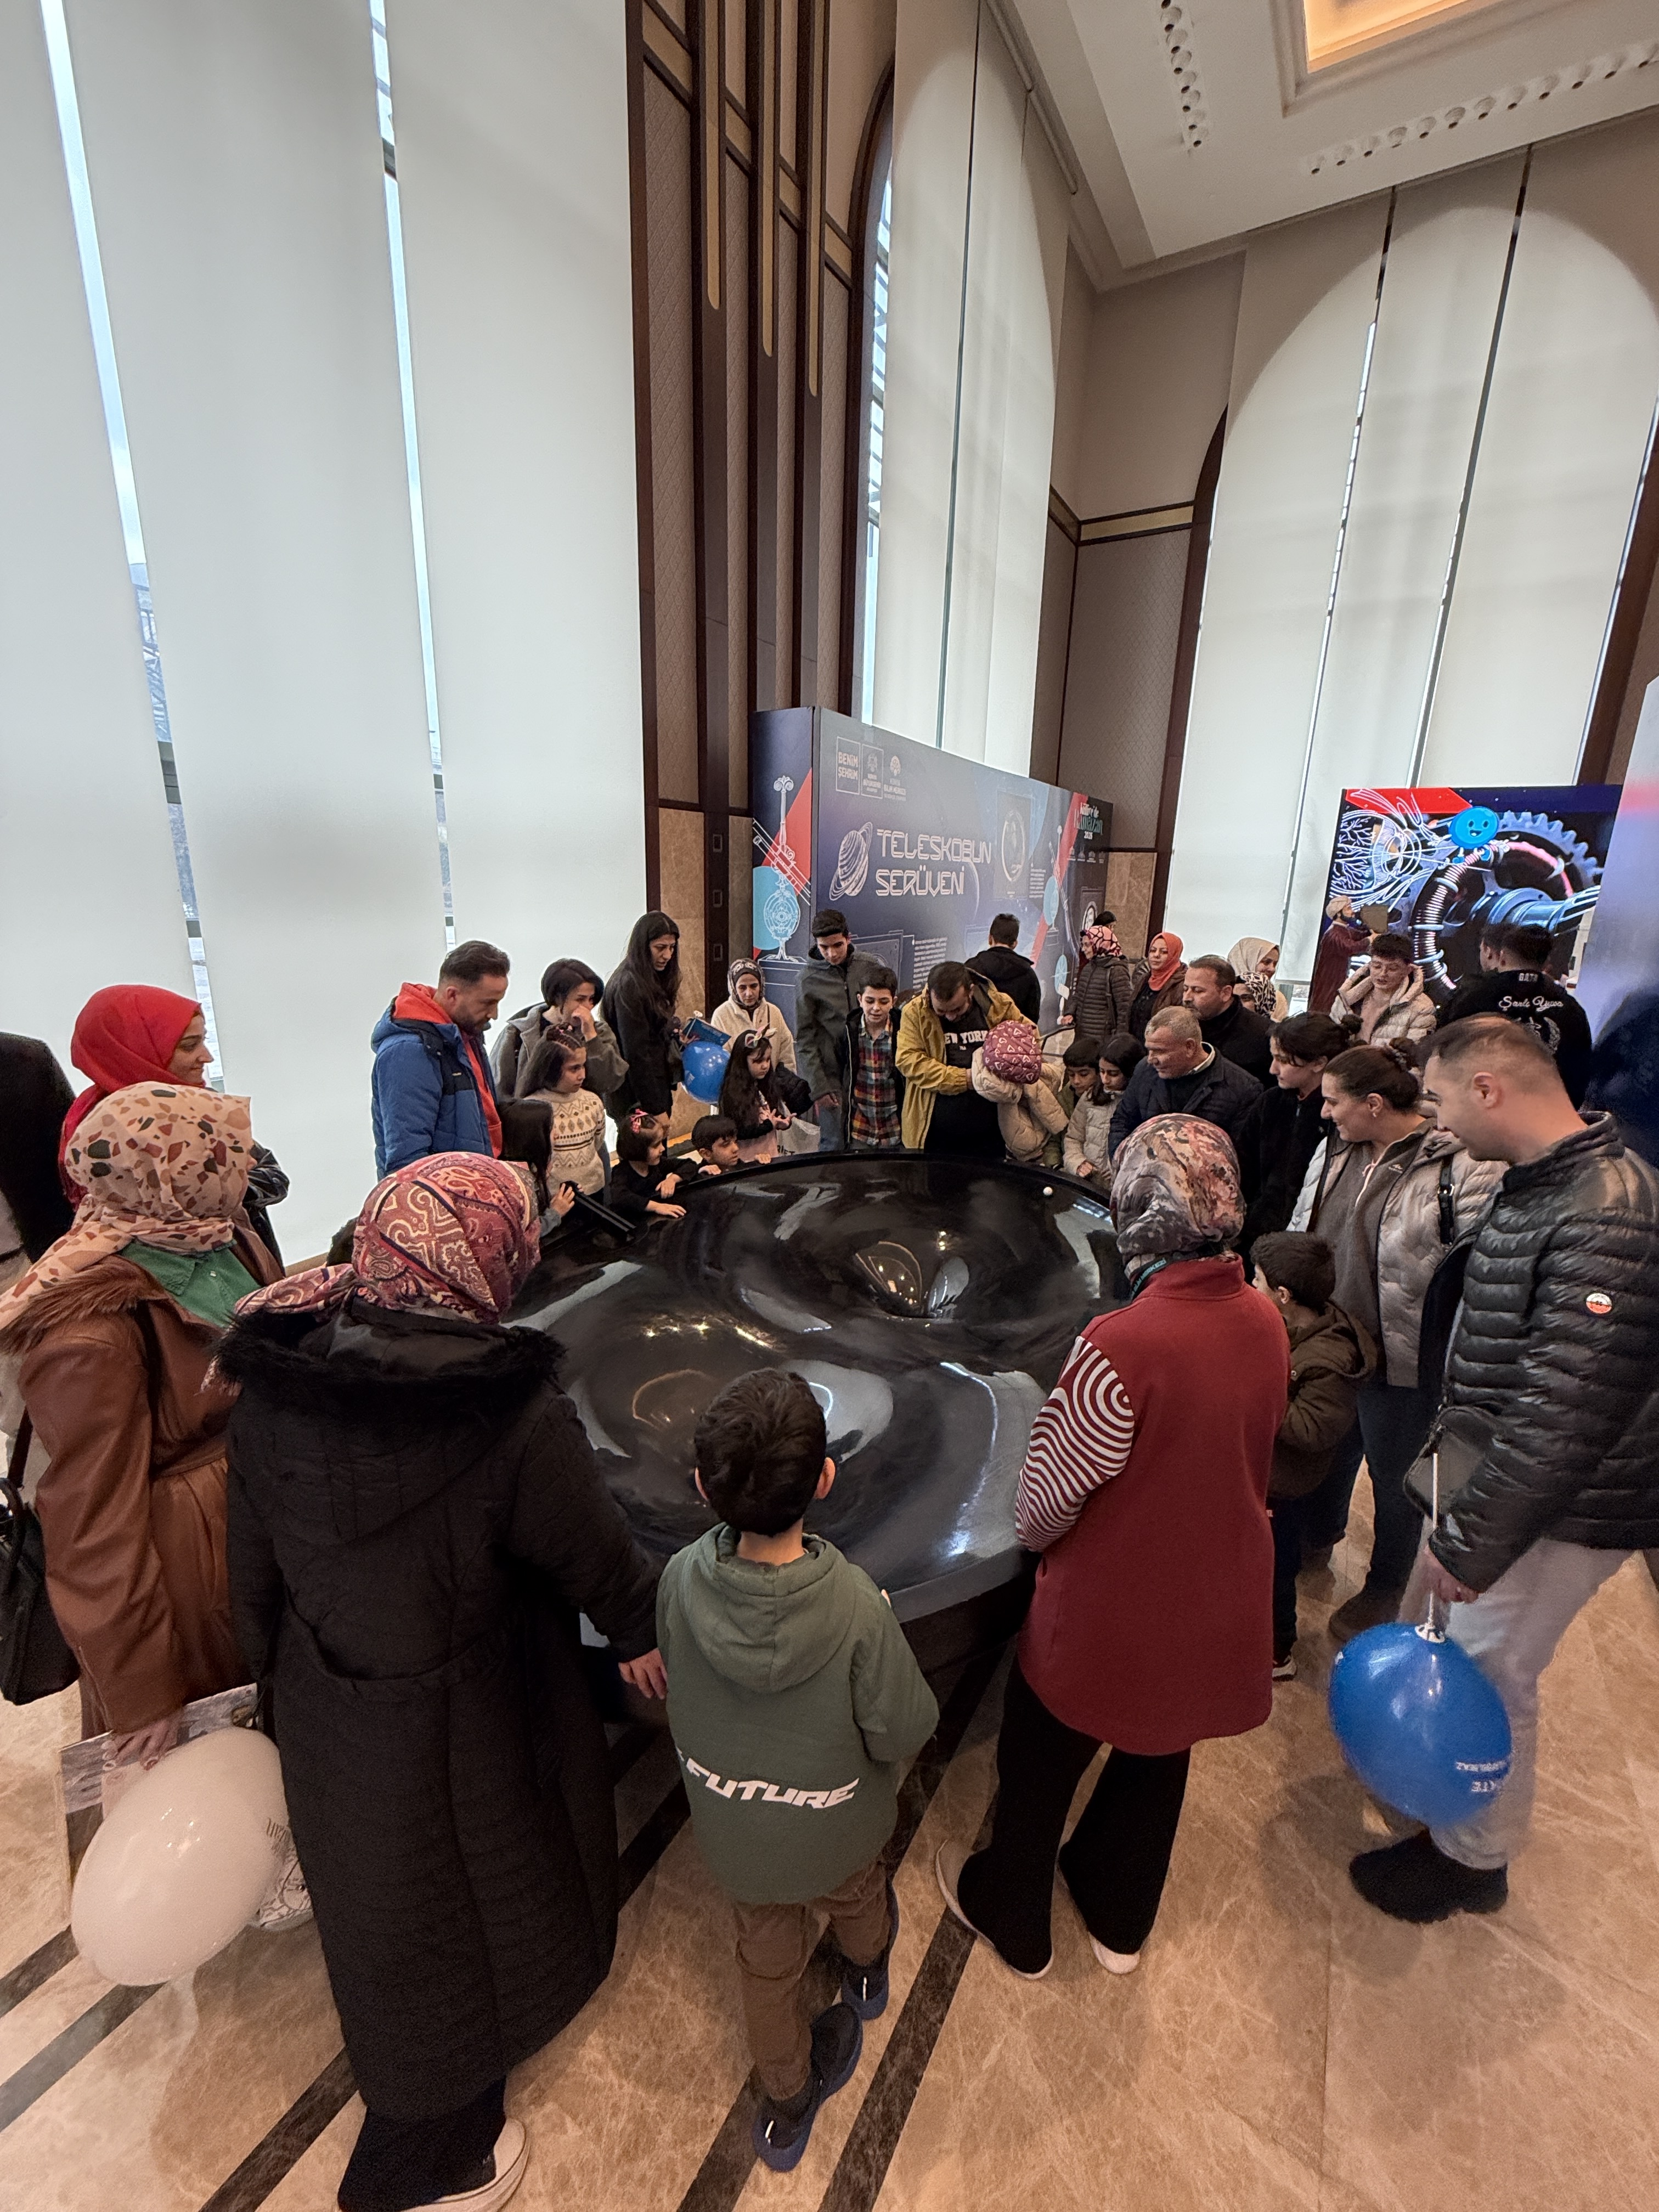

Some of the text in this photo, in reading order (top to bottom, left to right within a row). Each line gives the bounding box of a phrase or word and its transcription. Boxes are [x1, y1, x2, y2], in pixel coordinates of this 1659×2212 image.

[838, 751, 859, 768] BENİM
[877, 828, 992, 864] TELESKOBUN
[876, 864, 964, 897] SERÜVENİ
[944, 1032, 958, 1045] EW
[686, 1757, 859, 1809] FUTURE
